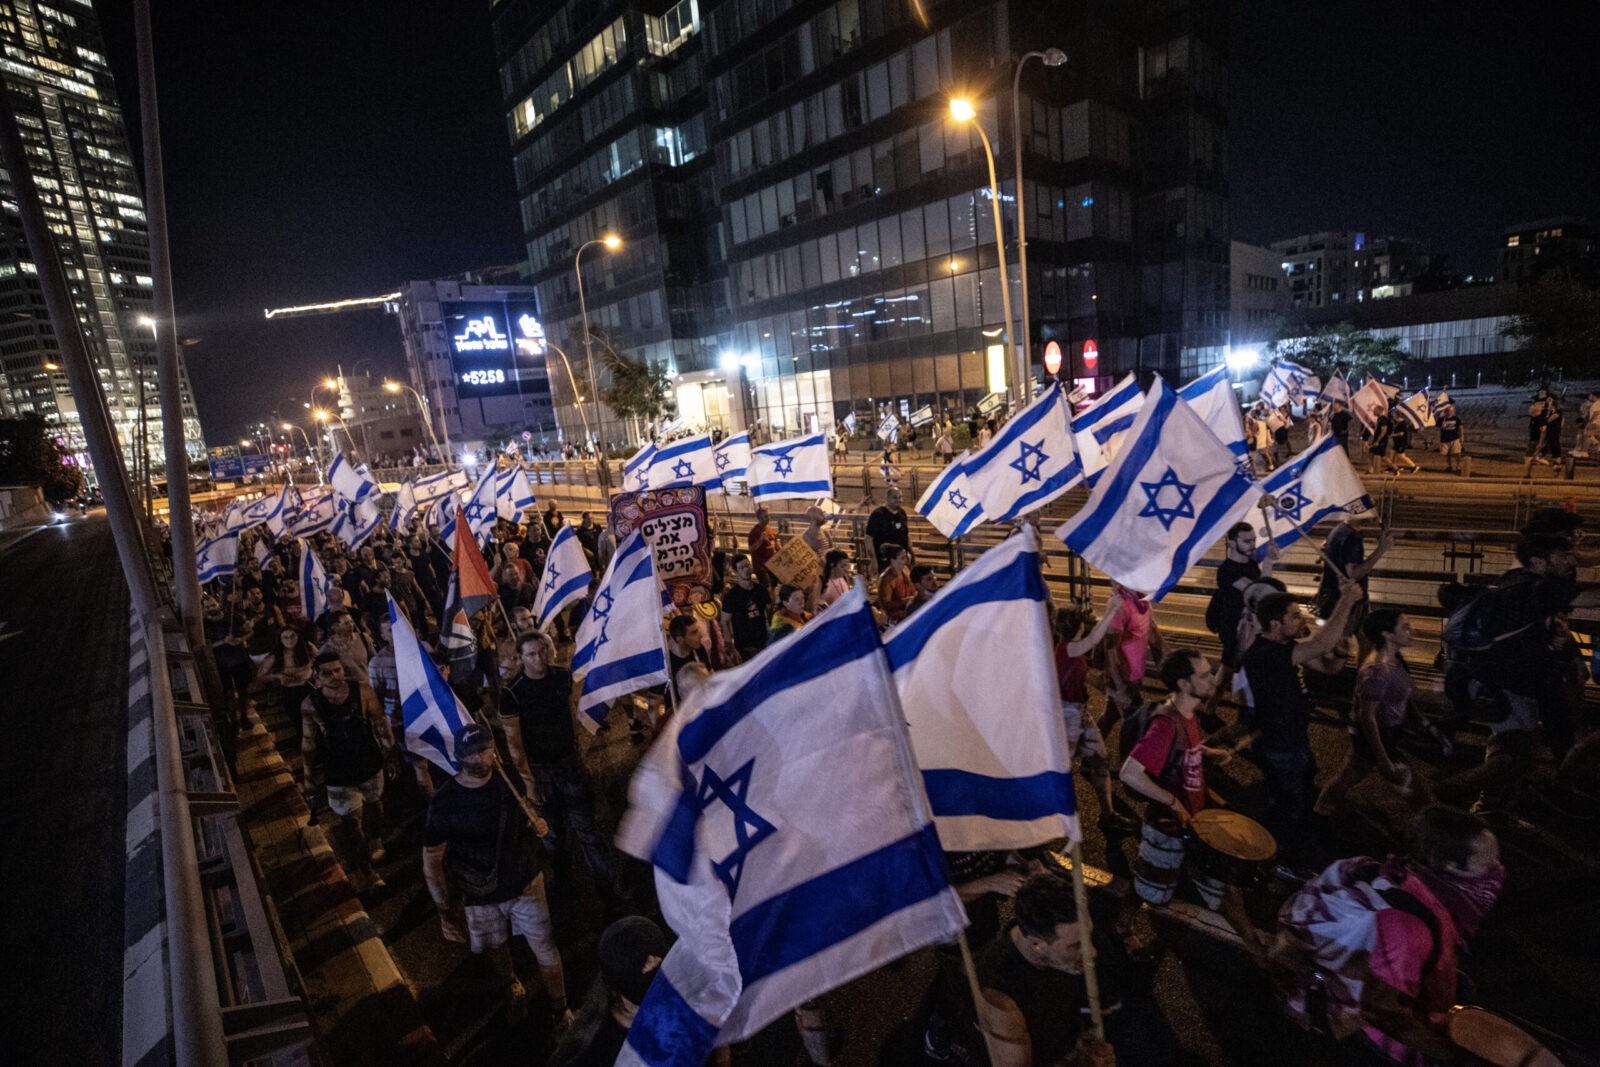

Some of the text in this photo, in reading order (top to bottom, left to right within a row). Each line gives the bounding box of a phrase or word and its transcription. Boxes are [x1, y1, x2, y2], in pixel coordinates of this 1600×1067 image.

[643, 516, 693, 536] מצילים
[656, 532, 681, 546] את
[657, 545, 689, 561] הדמ
